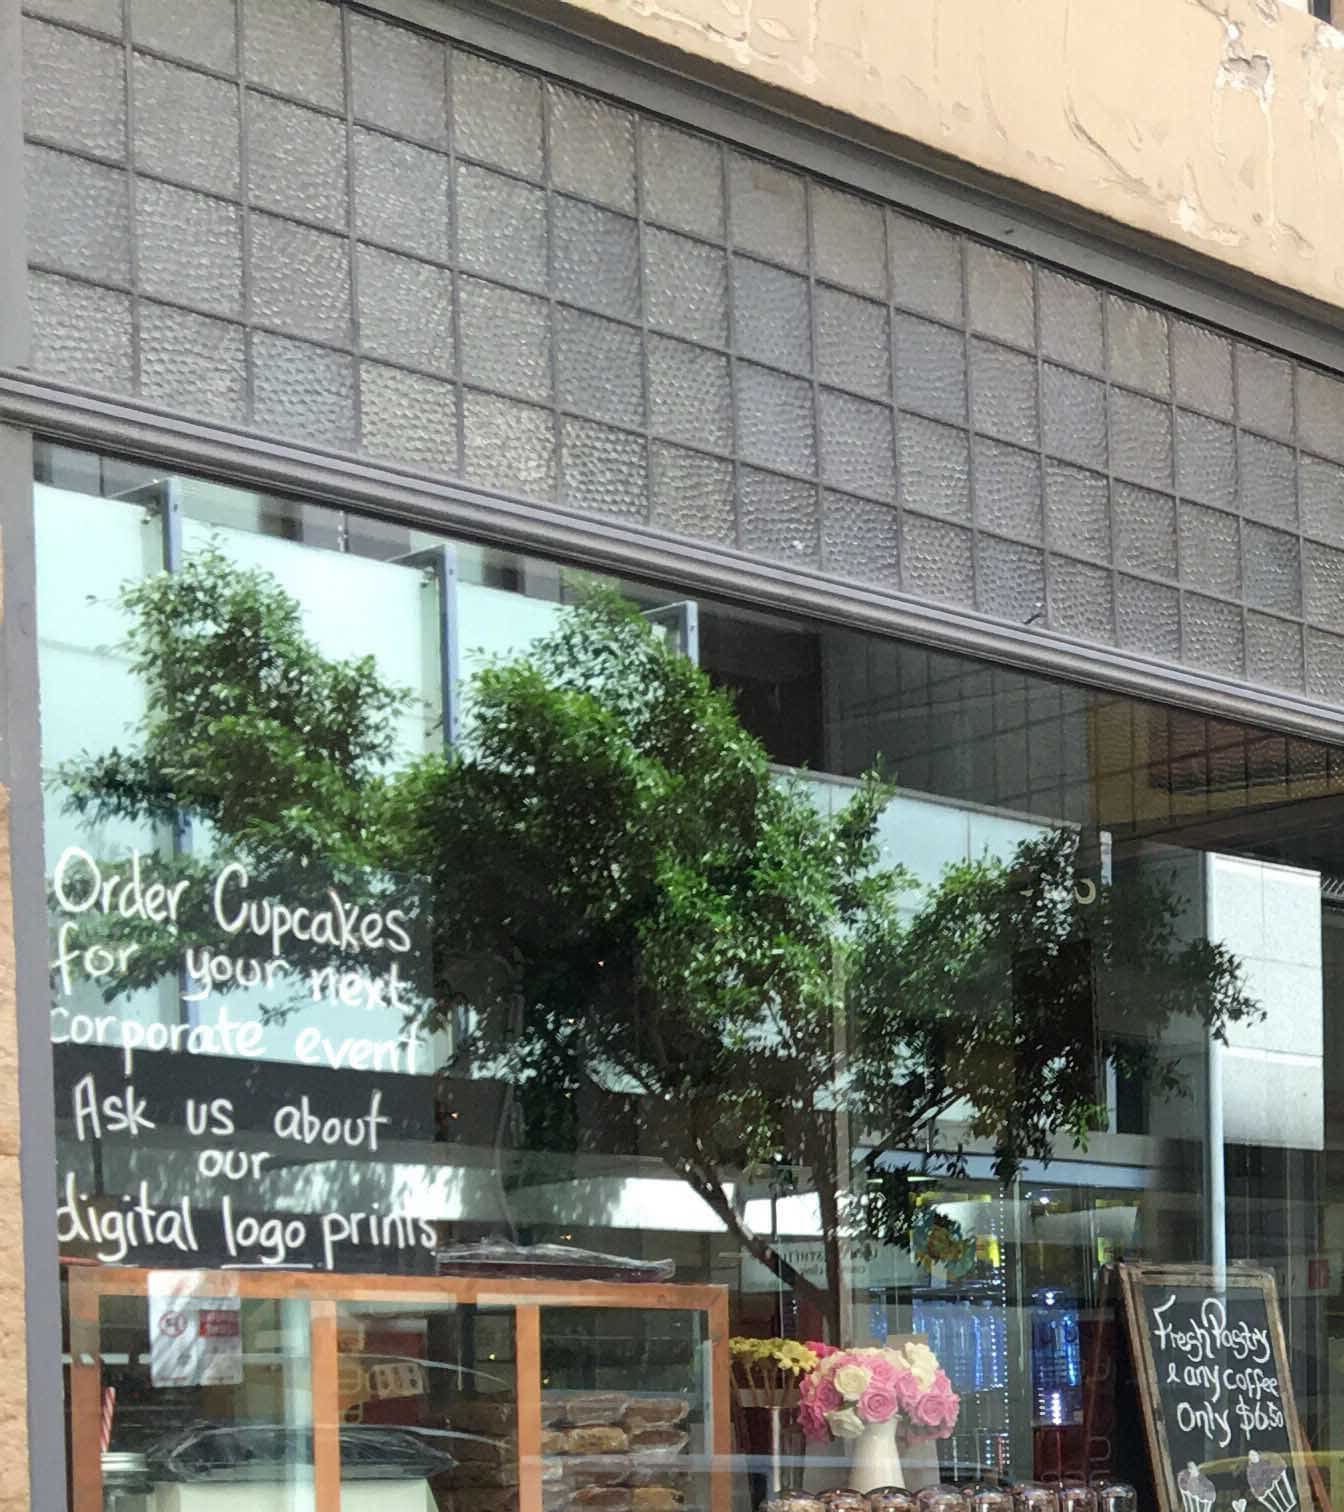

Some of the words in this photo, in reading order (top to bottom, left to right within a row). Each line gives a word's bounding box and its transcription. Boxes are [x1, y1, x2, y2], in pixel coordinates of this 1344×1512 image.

[54, 846, 190, 922] Order
[214, 863, 412, 955] Cupcakes
[50, 923, 138, 995] for
[183, 950, 287, 1000] your
[311, 963, 408, 1012] next
[51, 1006, 266, 1074] corporate
[296, 1024, 424, 1074] event
[74, 1074, 155, 1140] Ask
[187, 1098, 234, 1136] us
[274, 1090, 391, 1151] about
[199, 1149, 271, 1180] our
[56, 1174, 198, 1262] digital
[222, 1196, 306, 1264] logo
[323, 1207, 438, 1270] prints
[1152, 1295, 1214, 1361] Fresh
[1201, 1298, 1271, 1364] Pastry
[1184, 1365, 1219, 1402] any
[1177, 1400, 1232, 1448] Only
[1236, 1396, 1284, 1440] $6.50
